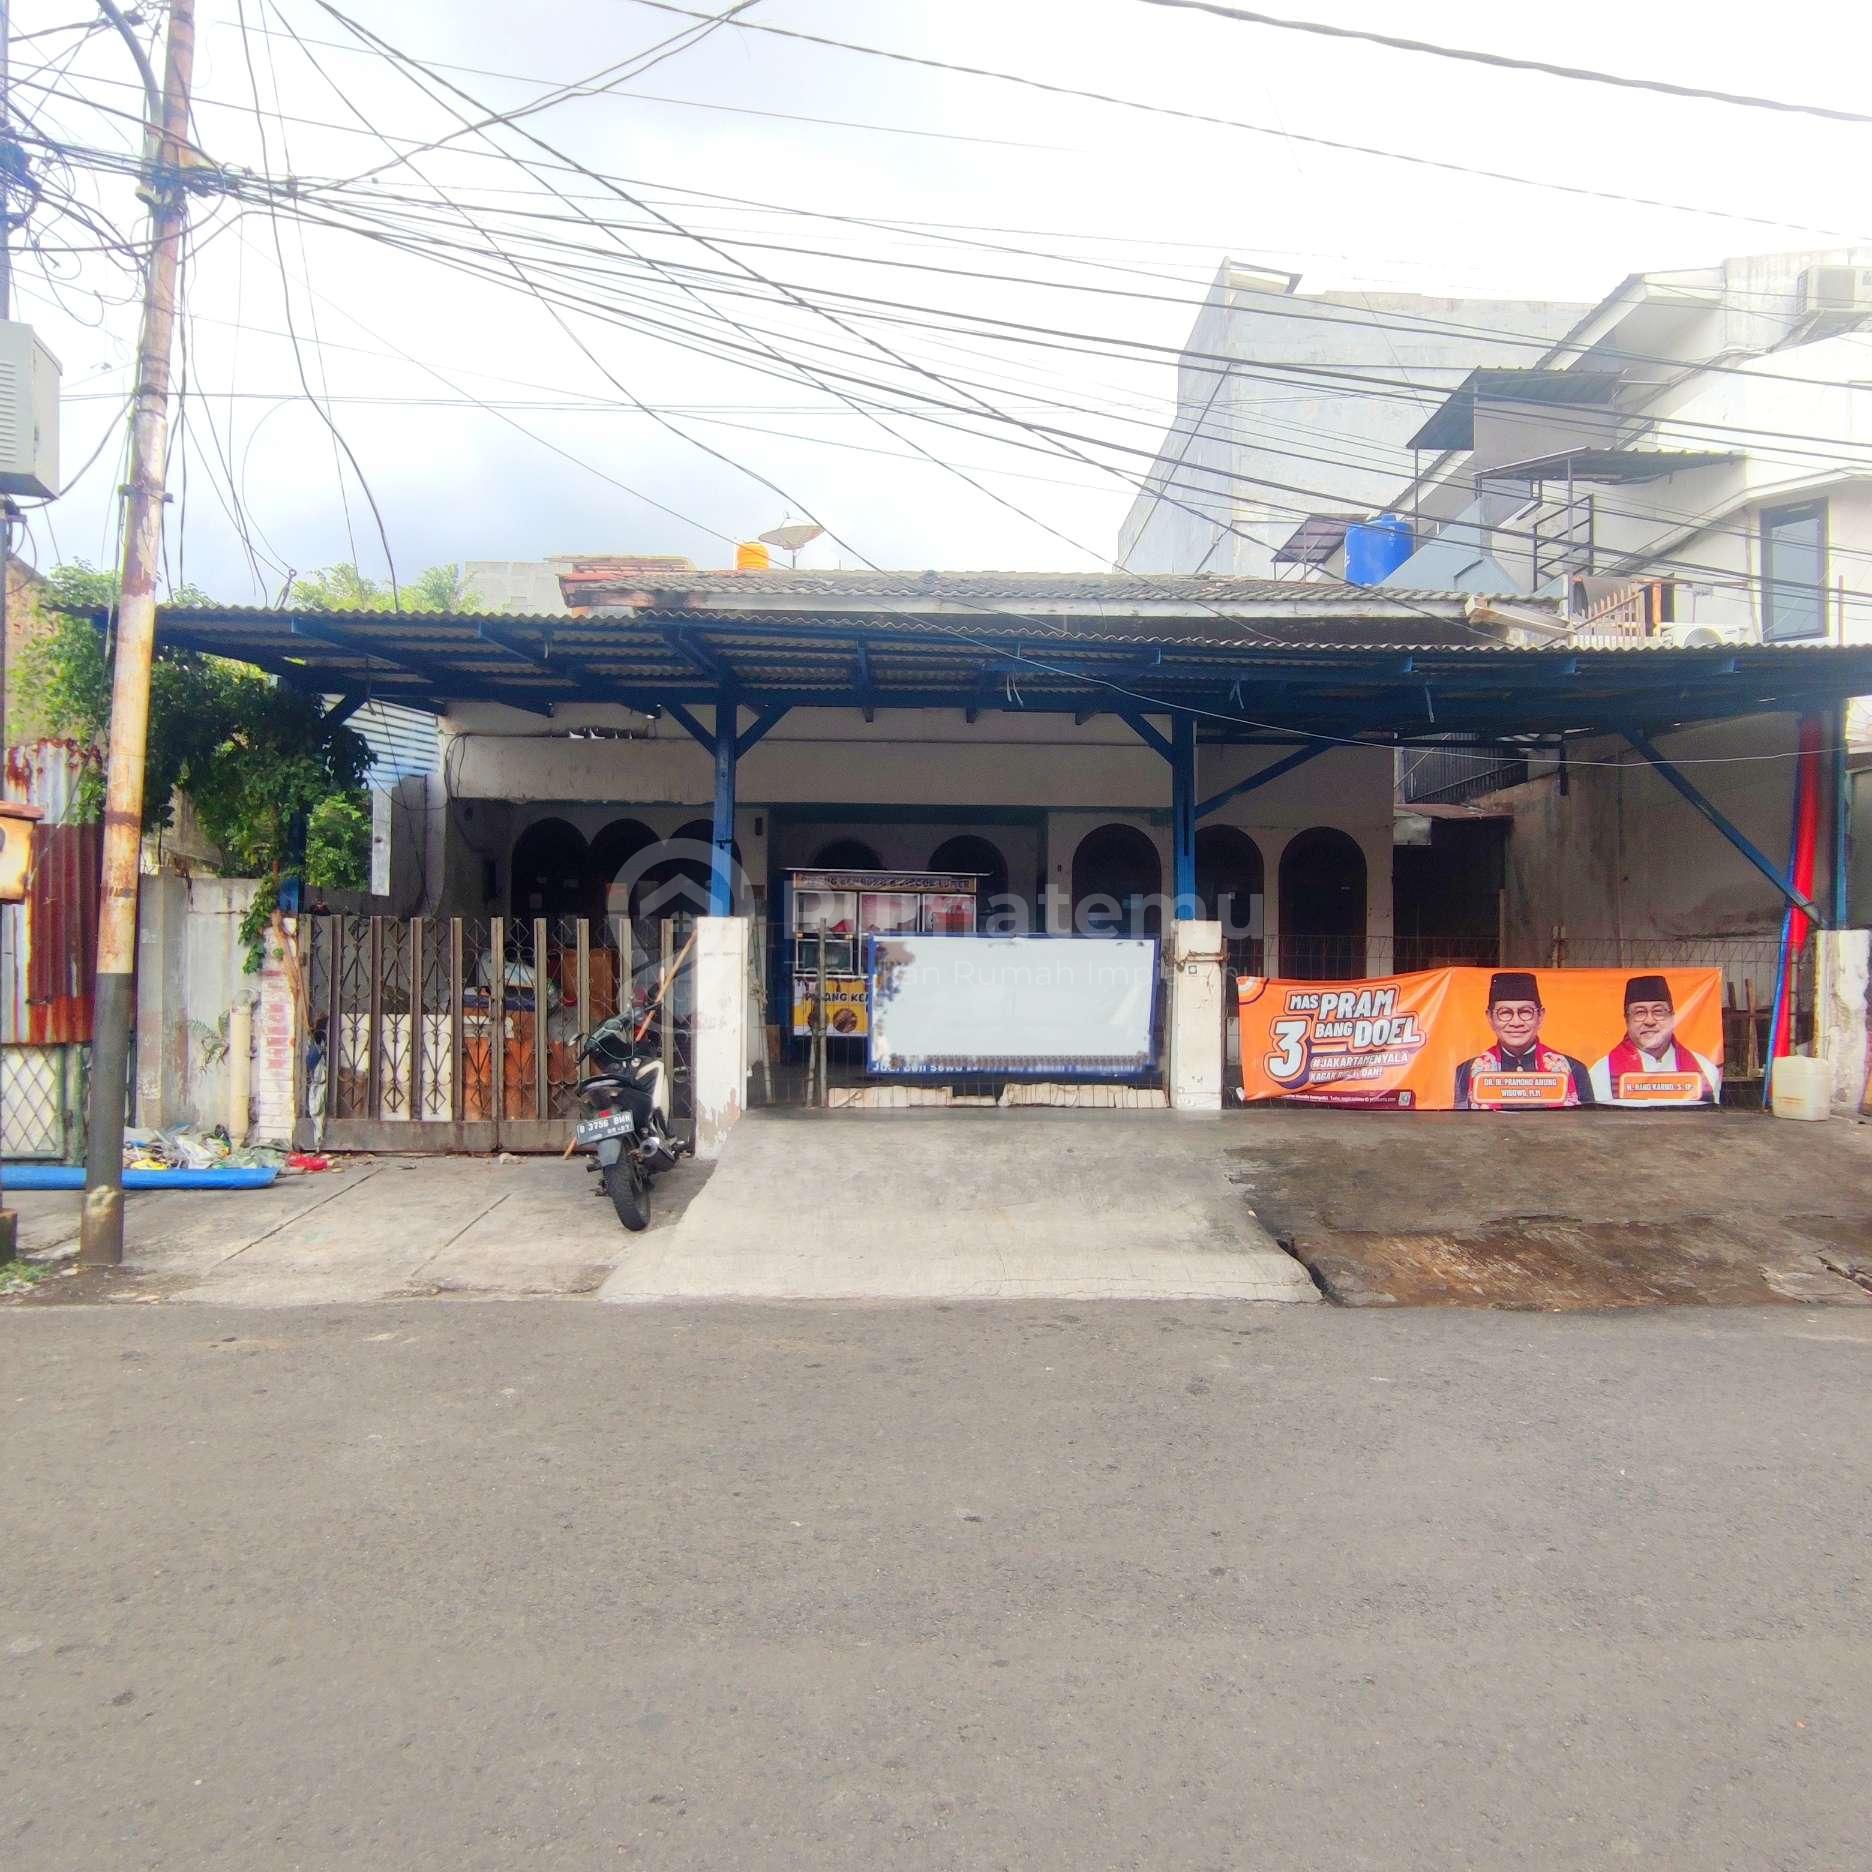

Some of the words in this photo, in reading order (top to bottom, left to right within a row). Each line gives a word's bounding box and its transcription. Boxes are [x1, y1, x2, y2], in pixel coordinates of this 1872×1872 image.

[1290, 993, 1319, 1010] MAS
[1319, 989, 1395, 1020] PRAM
[1315, 1021, 1352, 1038] BANG
[1353, 1016, 1420, 1048] DOEL
[1268, 1020, 1306, 1077] 3
